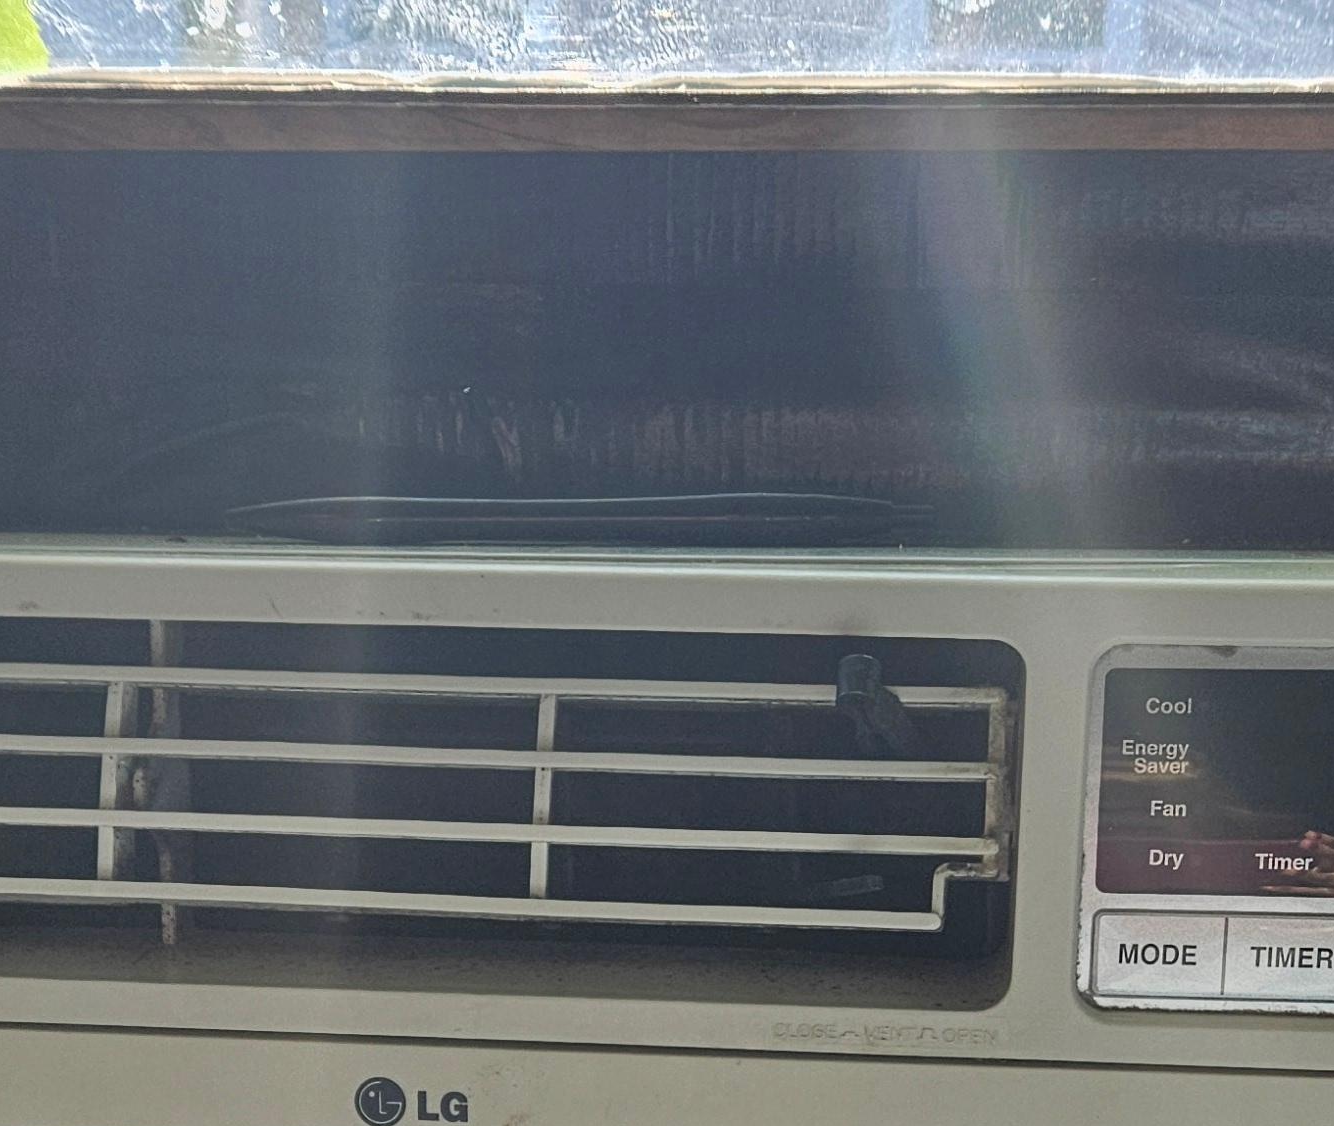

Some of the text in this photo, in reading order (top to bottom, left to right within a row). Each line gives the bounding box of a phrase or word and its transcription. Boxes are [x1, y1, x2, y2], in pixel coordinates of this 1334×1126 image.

[1145, 697, 1193, 715] Cool
[1121, 739, 1190, 760] Energy
[1133, 757, 1190, 775] Saver
[1149, 800, 1188, 818] Fan
[1148, 849, 1185, 871] Dry
[1254, 852, 1314, 872] Timer
[1117, 943, 1198, 967] MODE
[1250, 945, 1334, 970] TIMER
[417, 1090, 469, 1123] LG
